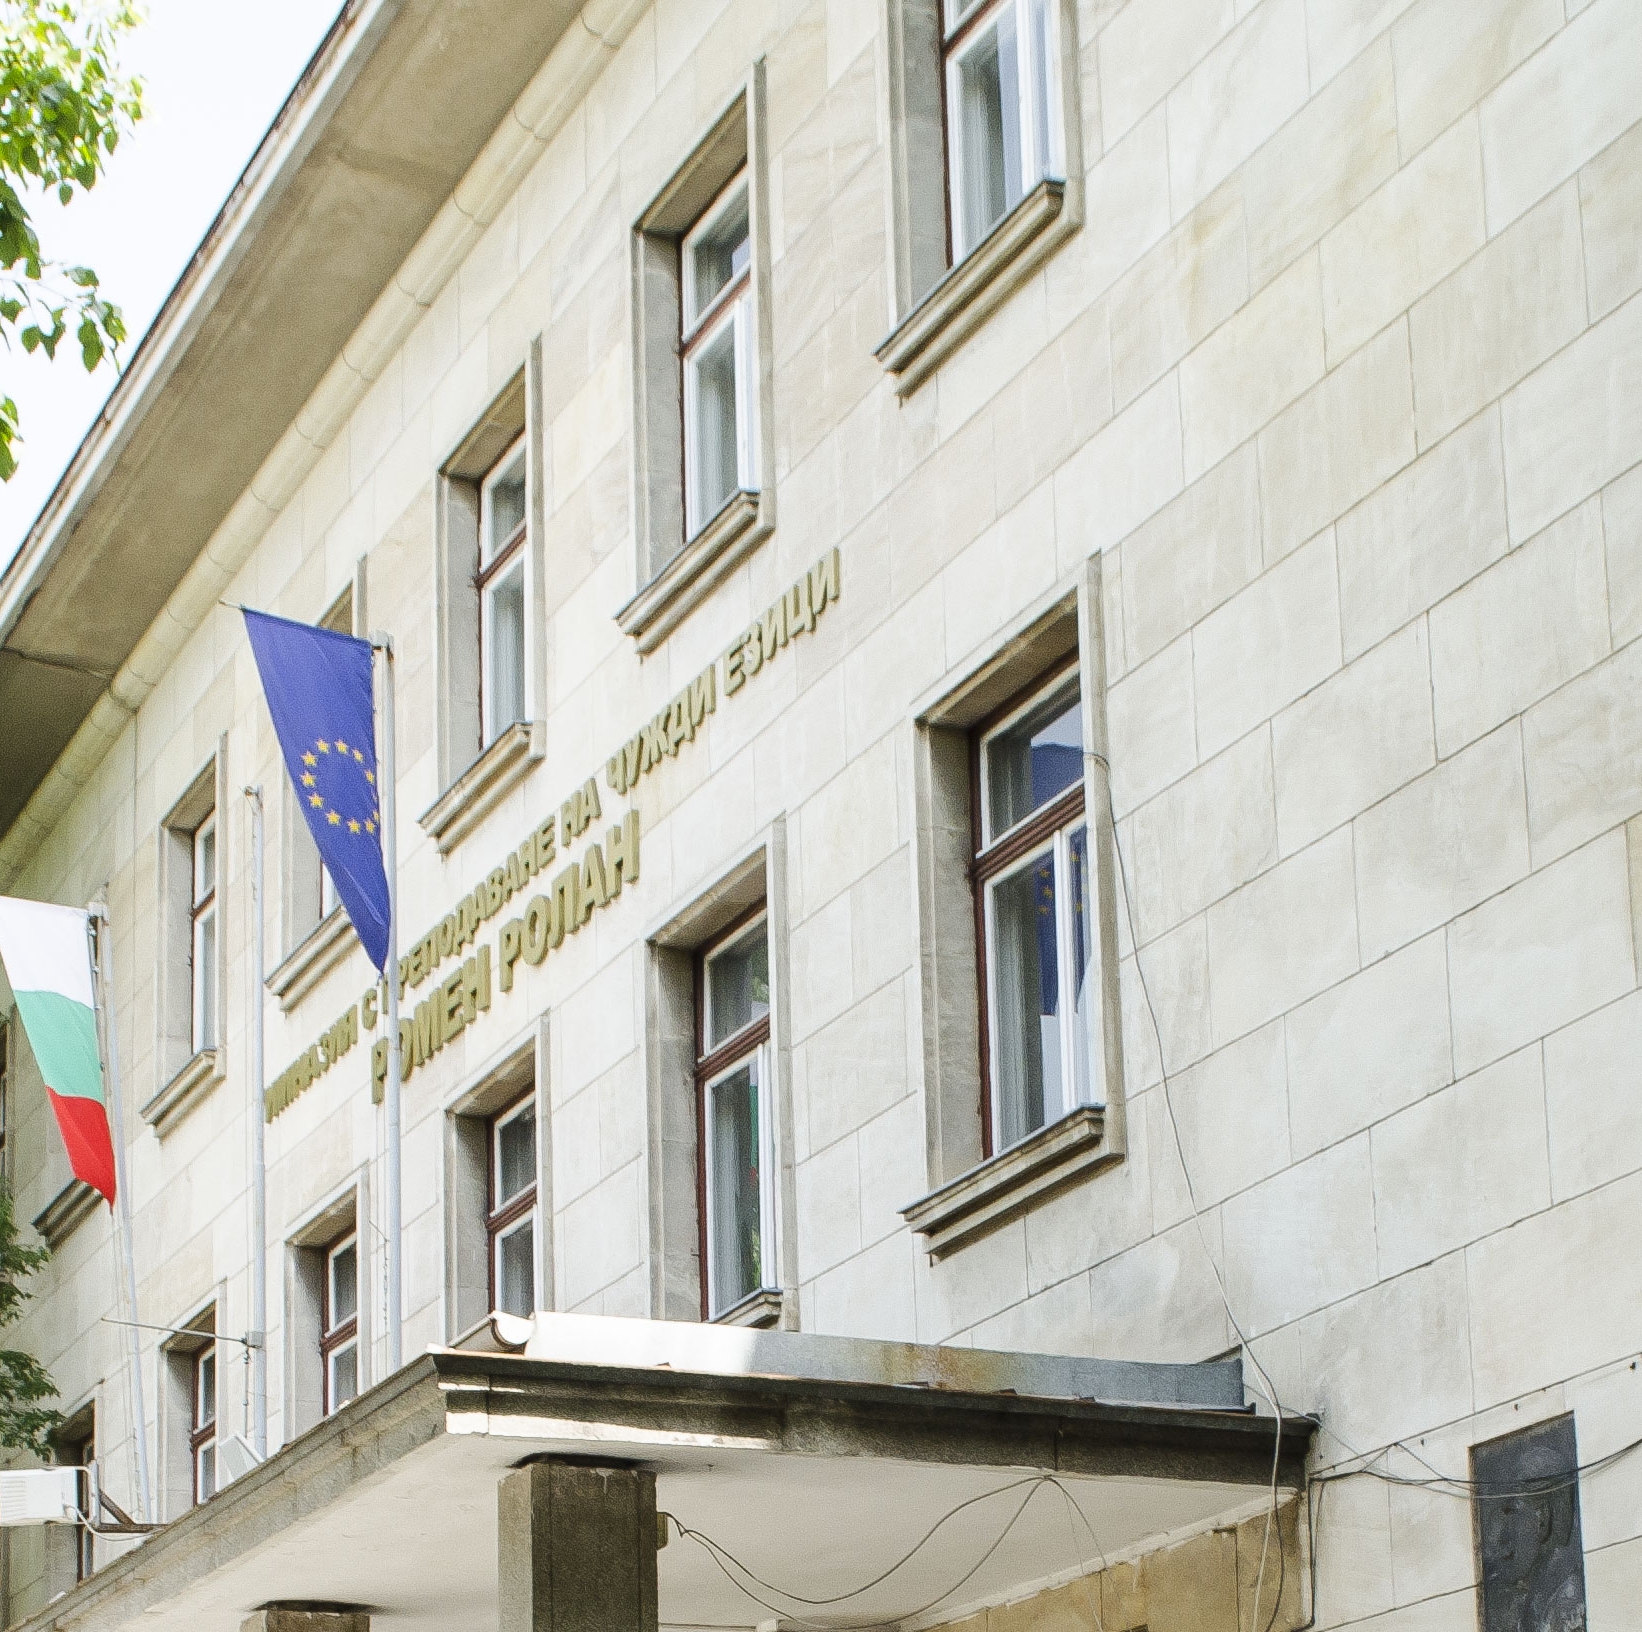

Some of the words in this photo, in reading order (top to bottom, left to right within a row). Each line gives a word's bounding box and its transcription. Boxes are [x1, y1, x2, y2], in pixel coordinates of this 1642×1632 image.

[263, 1003, 358, 1125] ИМНАЗИЯ
[560, 778, 602, 848] НА
[607, 663, 717, 796] ЧУЖДИ
[723, 546, 842, 698] ЕЗИЦИ
[370, 943, 492, 1106] РОМЕН
[499, 809, 641, 993] РОЛАН
